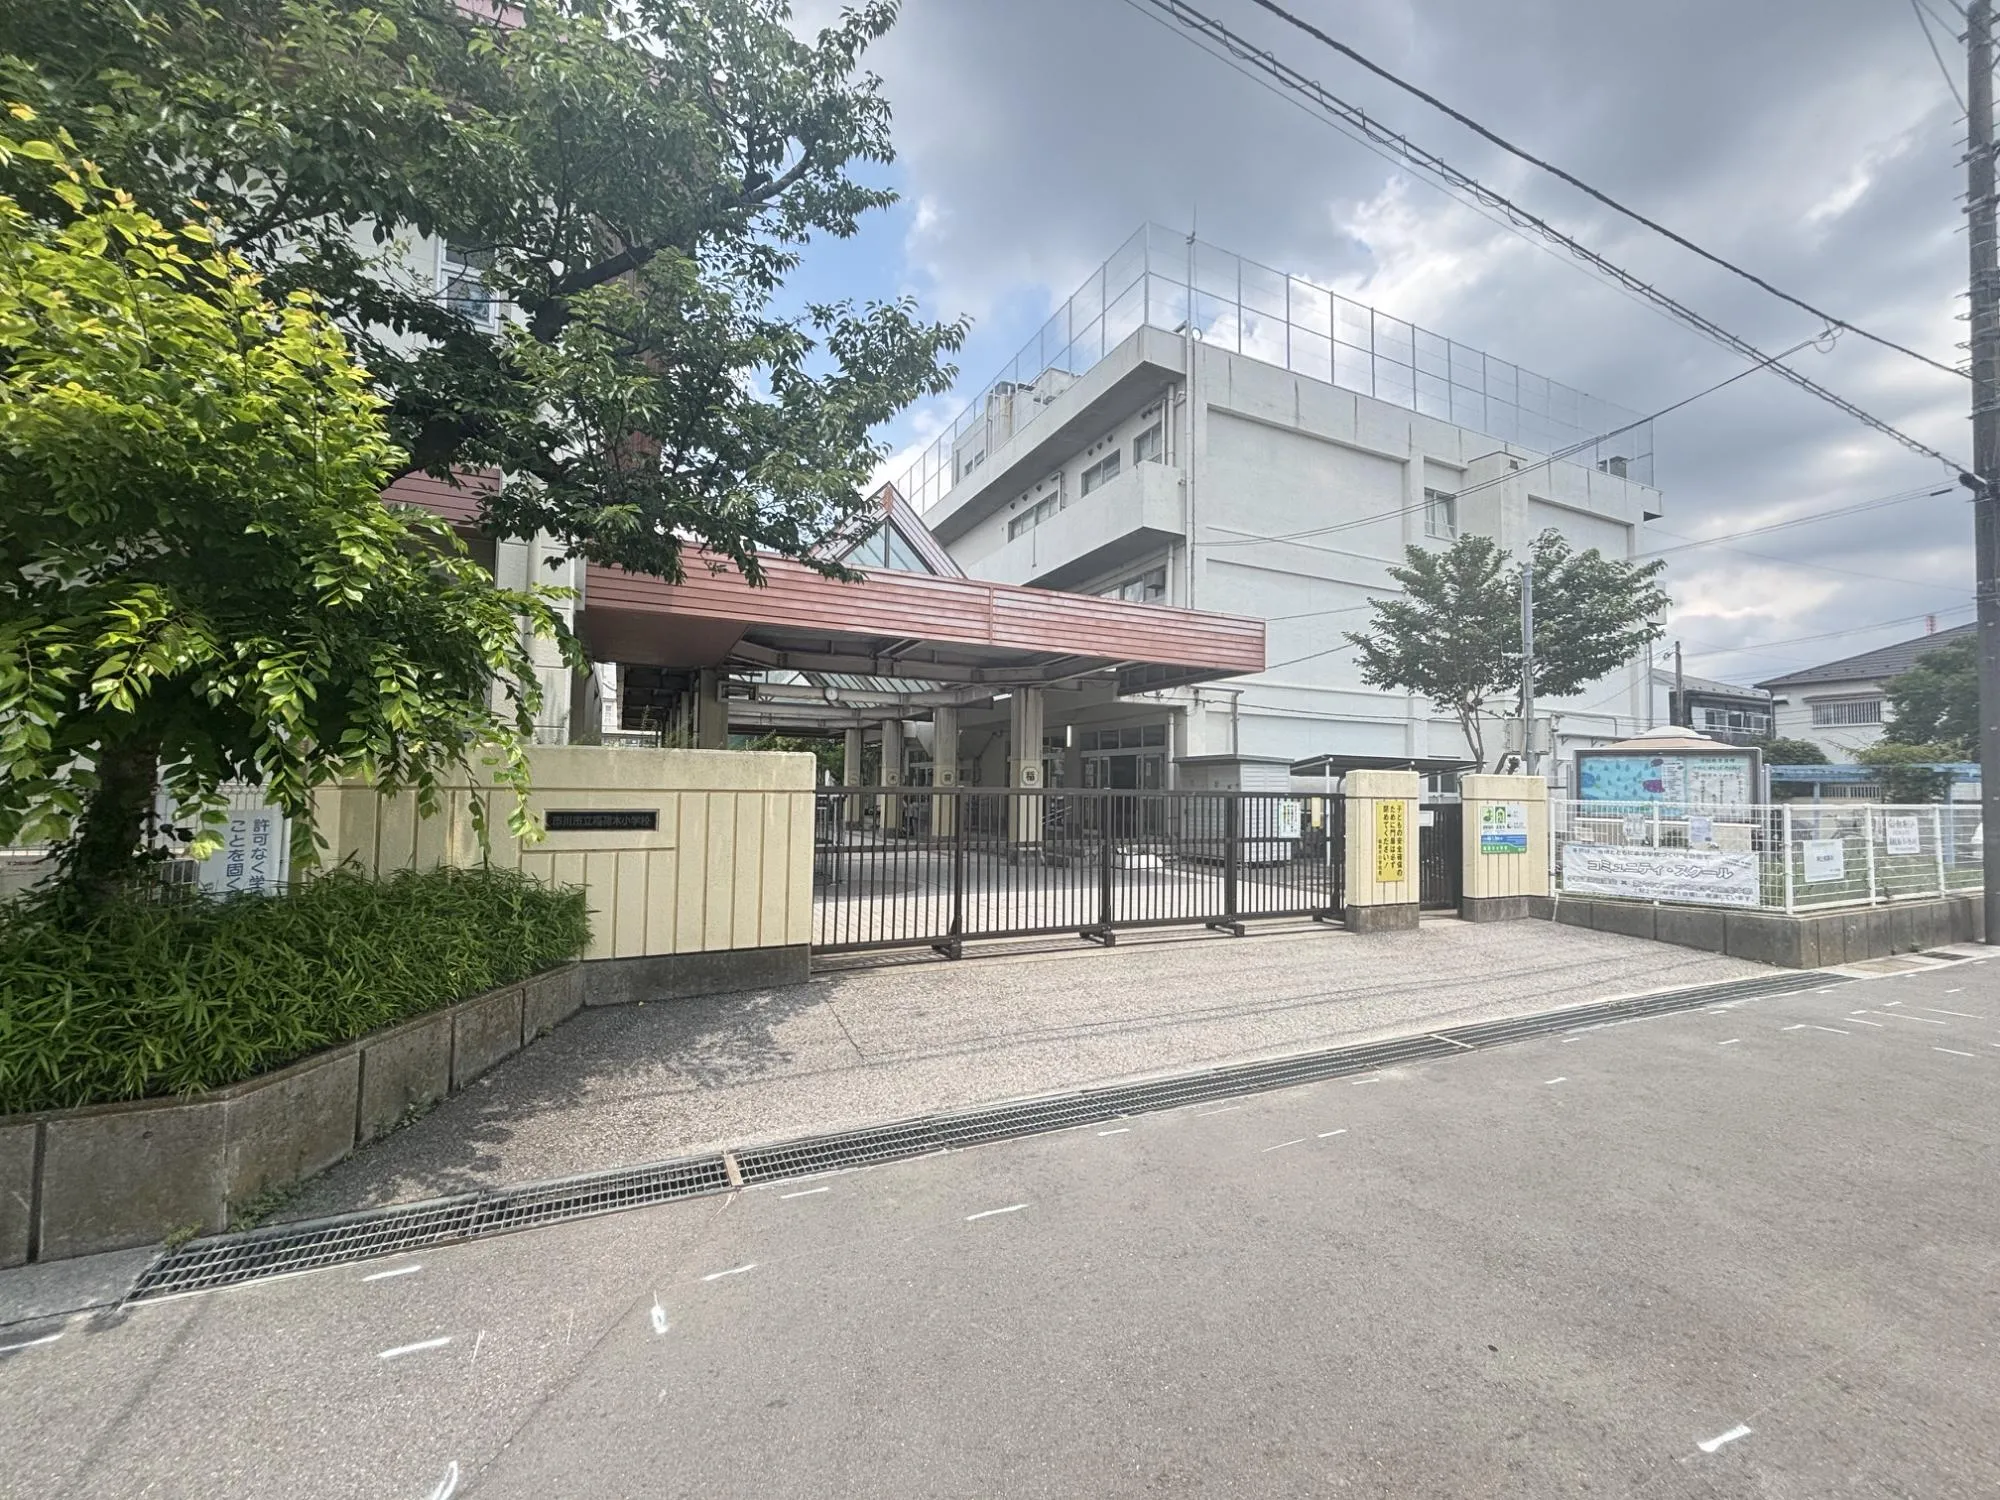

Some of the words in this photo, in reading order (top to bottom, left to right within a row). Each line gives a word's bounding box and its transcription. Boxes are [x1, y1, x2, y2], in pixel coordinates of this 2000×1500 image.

[226, 819, 246, 891] ことを固く
[249, 818, 270, 895] 許可なく学
[1587, 859, 1734, 880] コミュニティ・スクール
